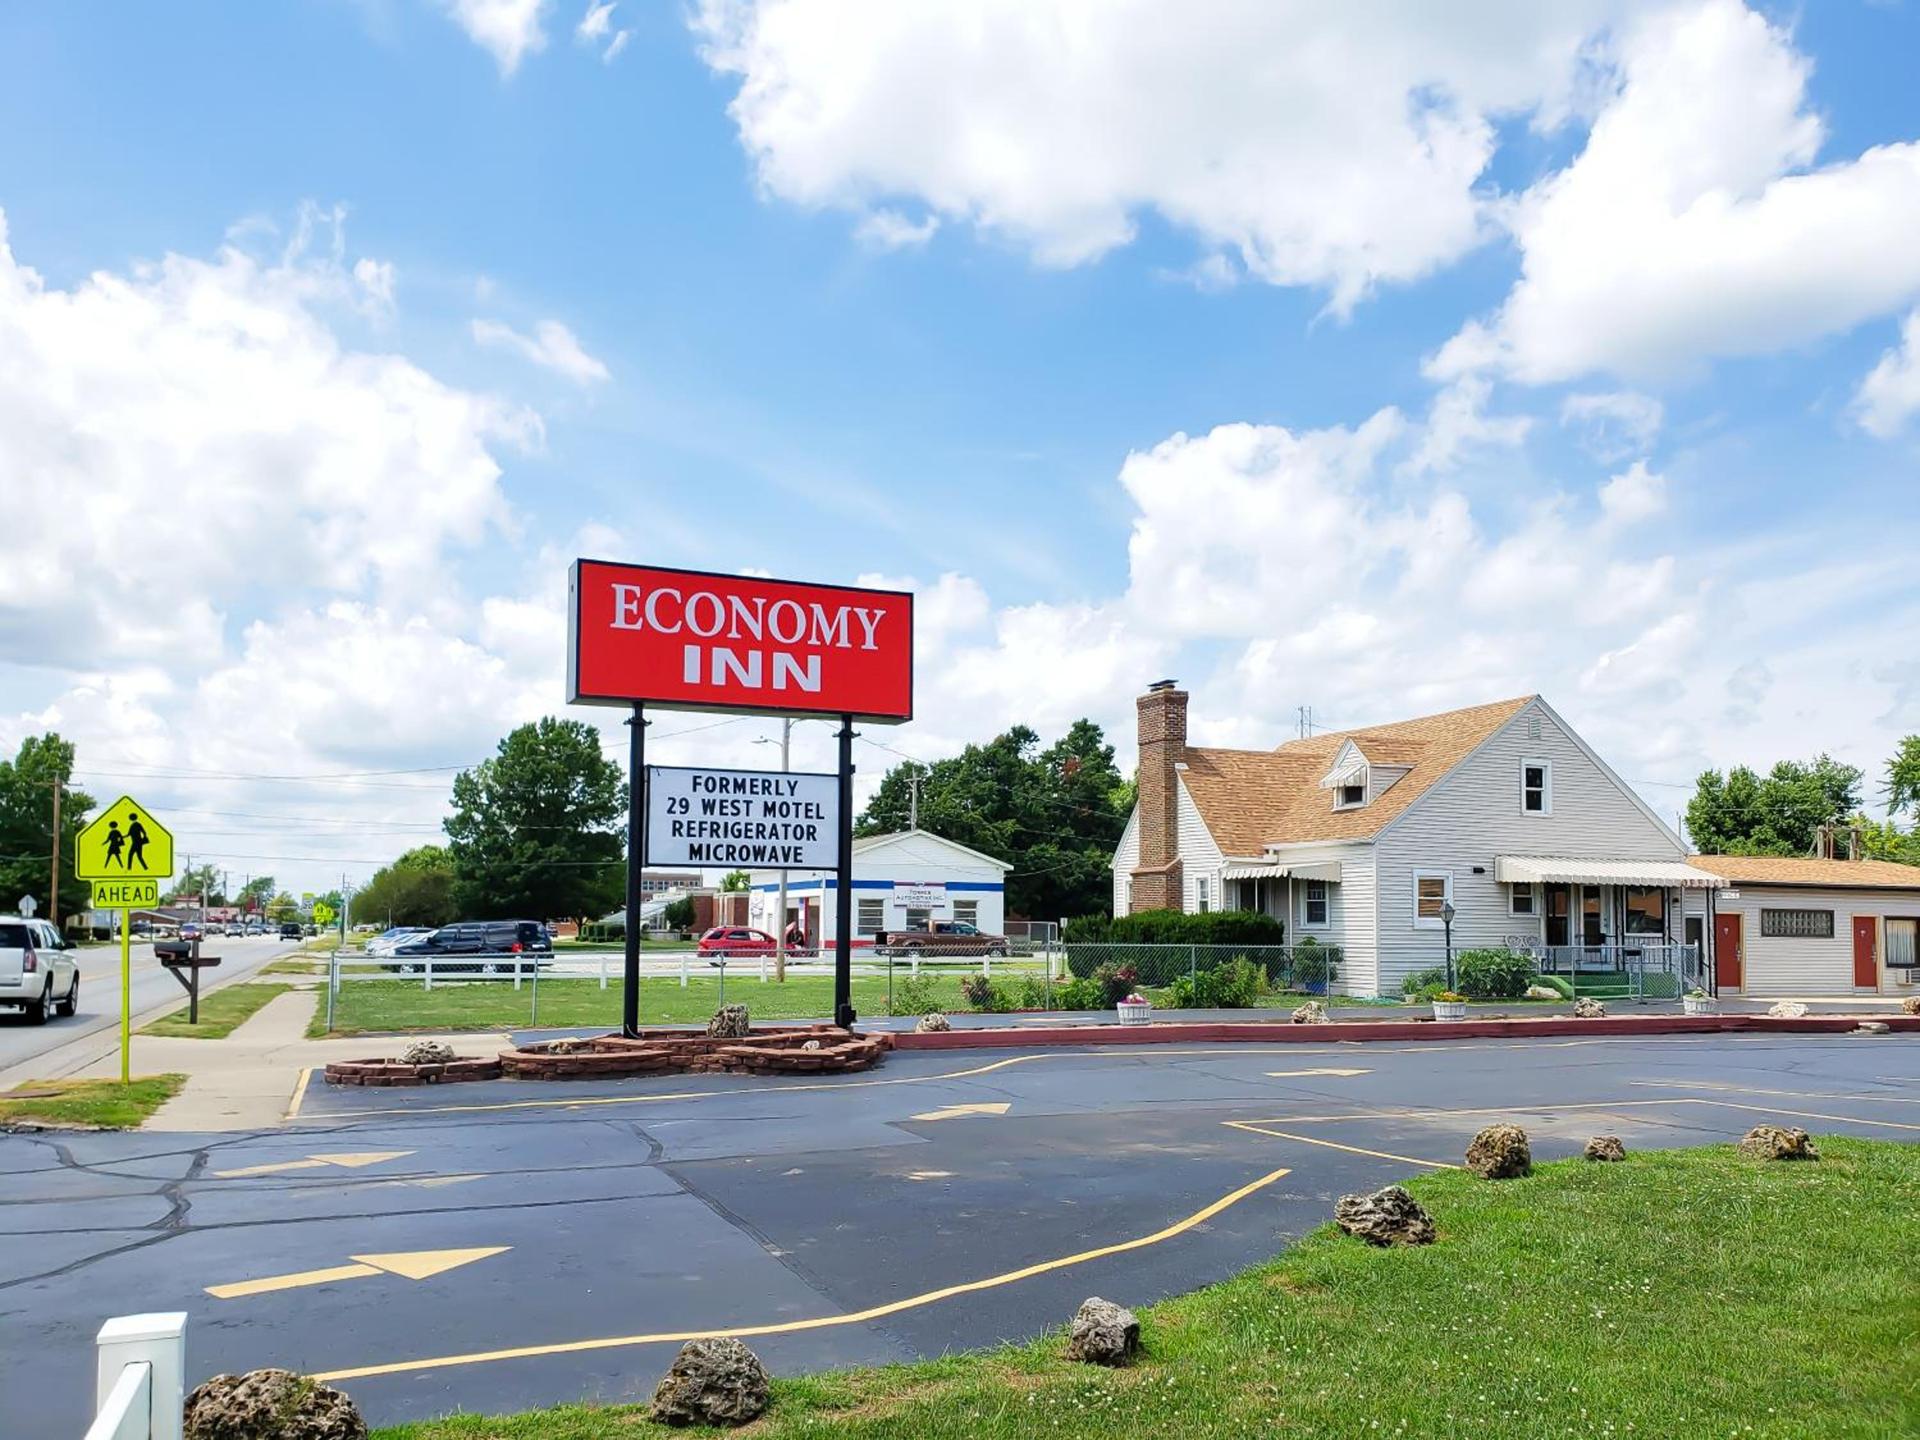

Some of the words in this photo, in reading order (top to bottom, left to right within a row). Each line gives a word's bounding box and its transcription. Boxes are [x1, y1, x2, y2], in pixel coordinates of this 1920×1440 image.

[609, 582, 887, 651] ECONOMY
[683, 644, 822, 693] INN
[692, 775, 799, 797] FORMERLY
[666, 796, 690, 815] 29
[701, 798, 753, 817] WEST
[763, 800, 825, 820] MOTEL
[671, 819, 818, 842] REFRIGERATOR
[688, 842, 804, 864] MICROWAVE
[97, 886, 155, 902] AHEAD
